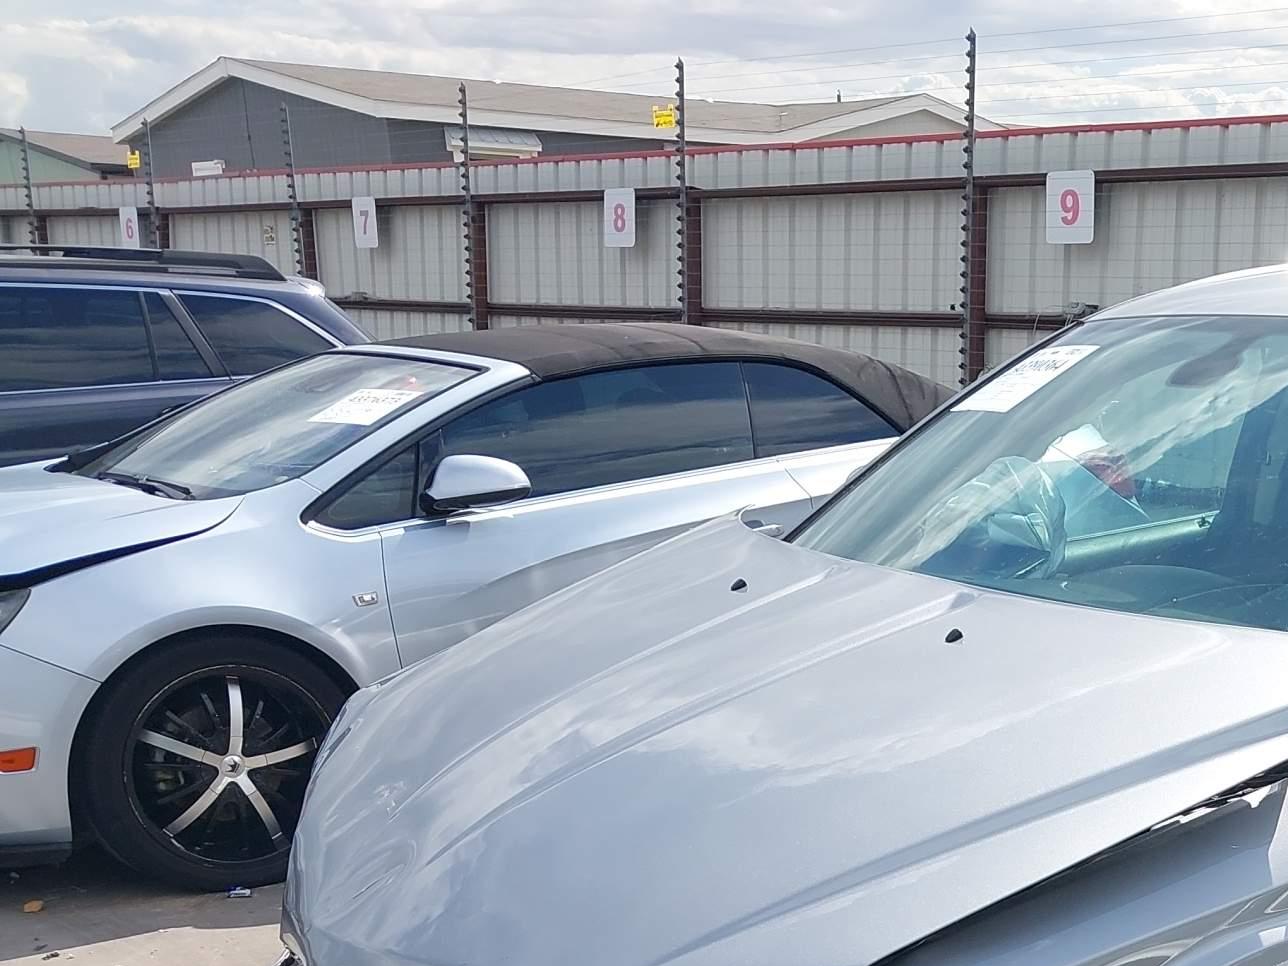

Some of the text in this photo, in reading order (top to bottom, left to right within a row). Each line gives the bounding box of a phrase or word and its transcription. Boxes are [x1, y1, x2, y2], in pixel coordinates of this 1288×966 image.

[613, 202, 626, 233] 8
[1060, 188, 1080, 226] 9
[125, 217, 134, 240] 6
[359, 209, 369, 235] 7
